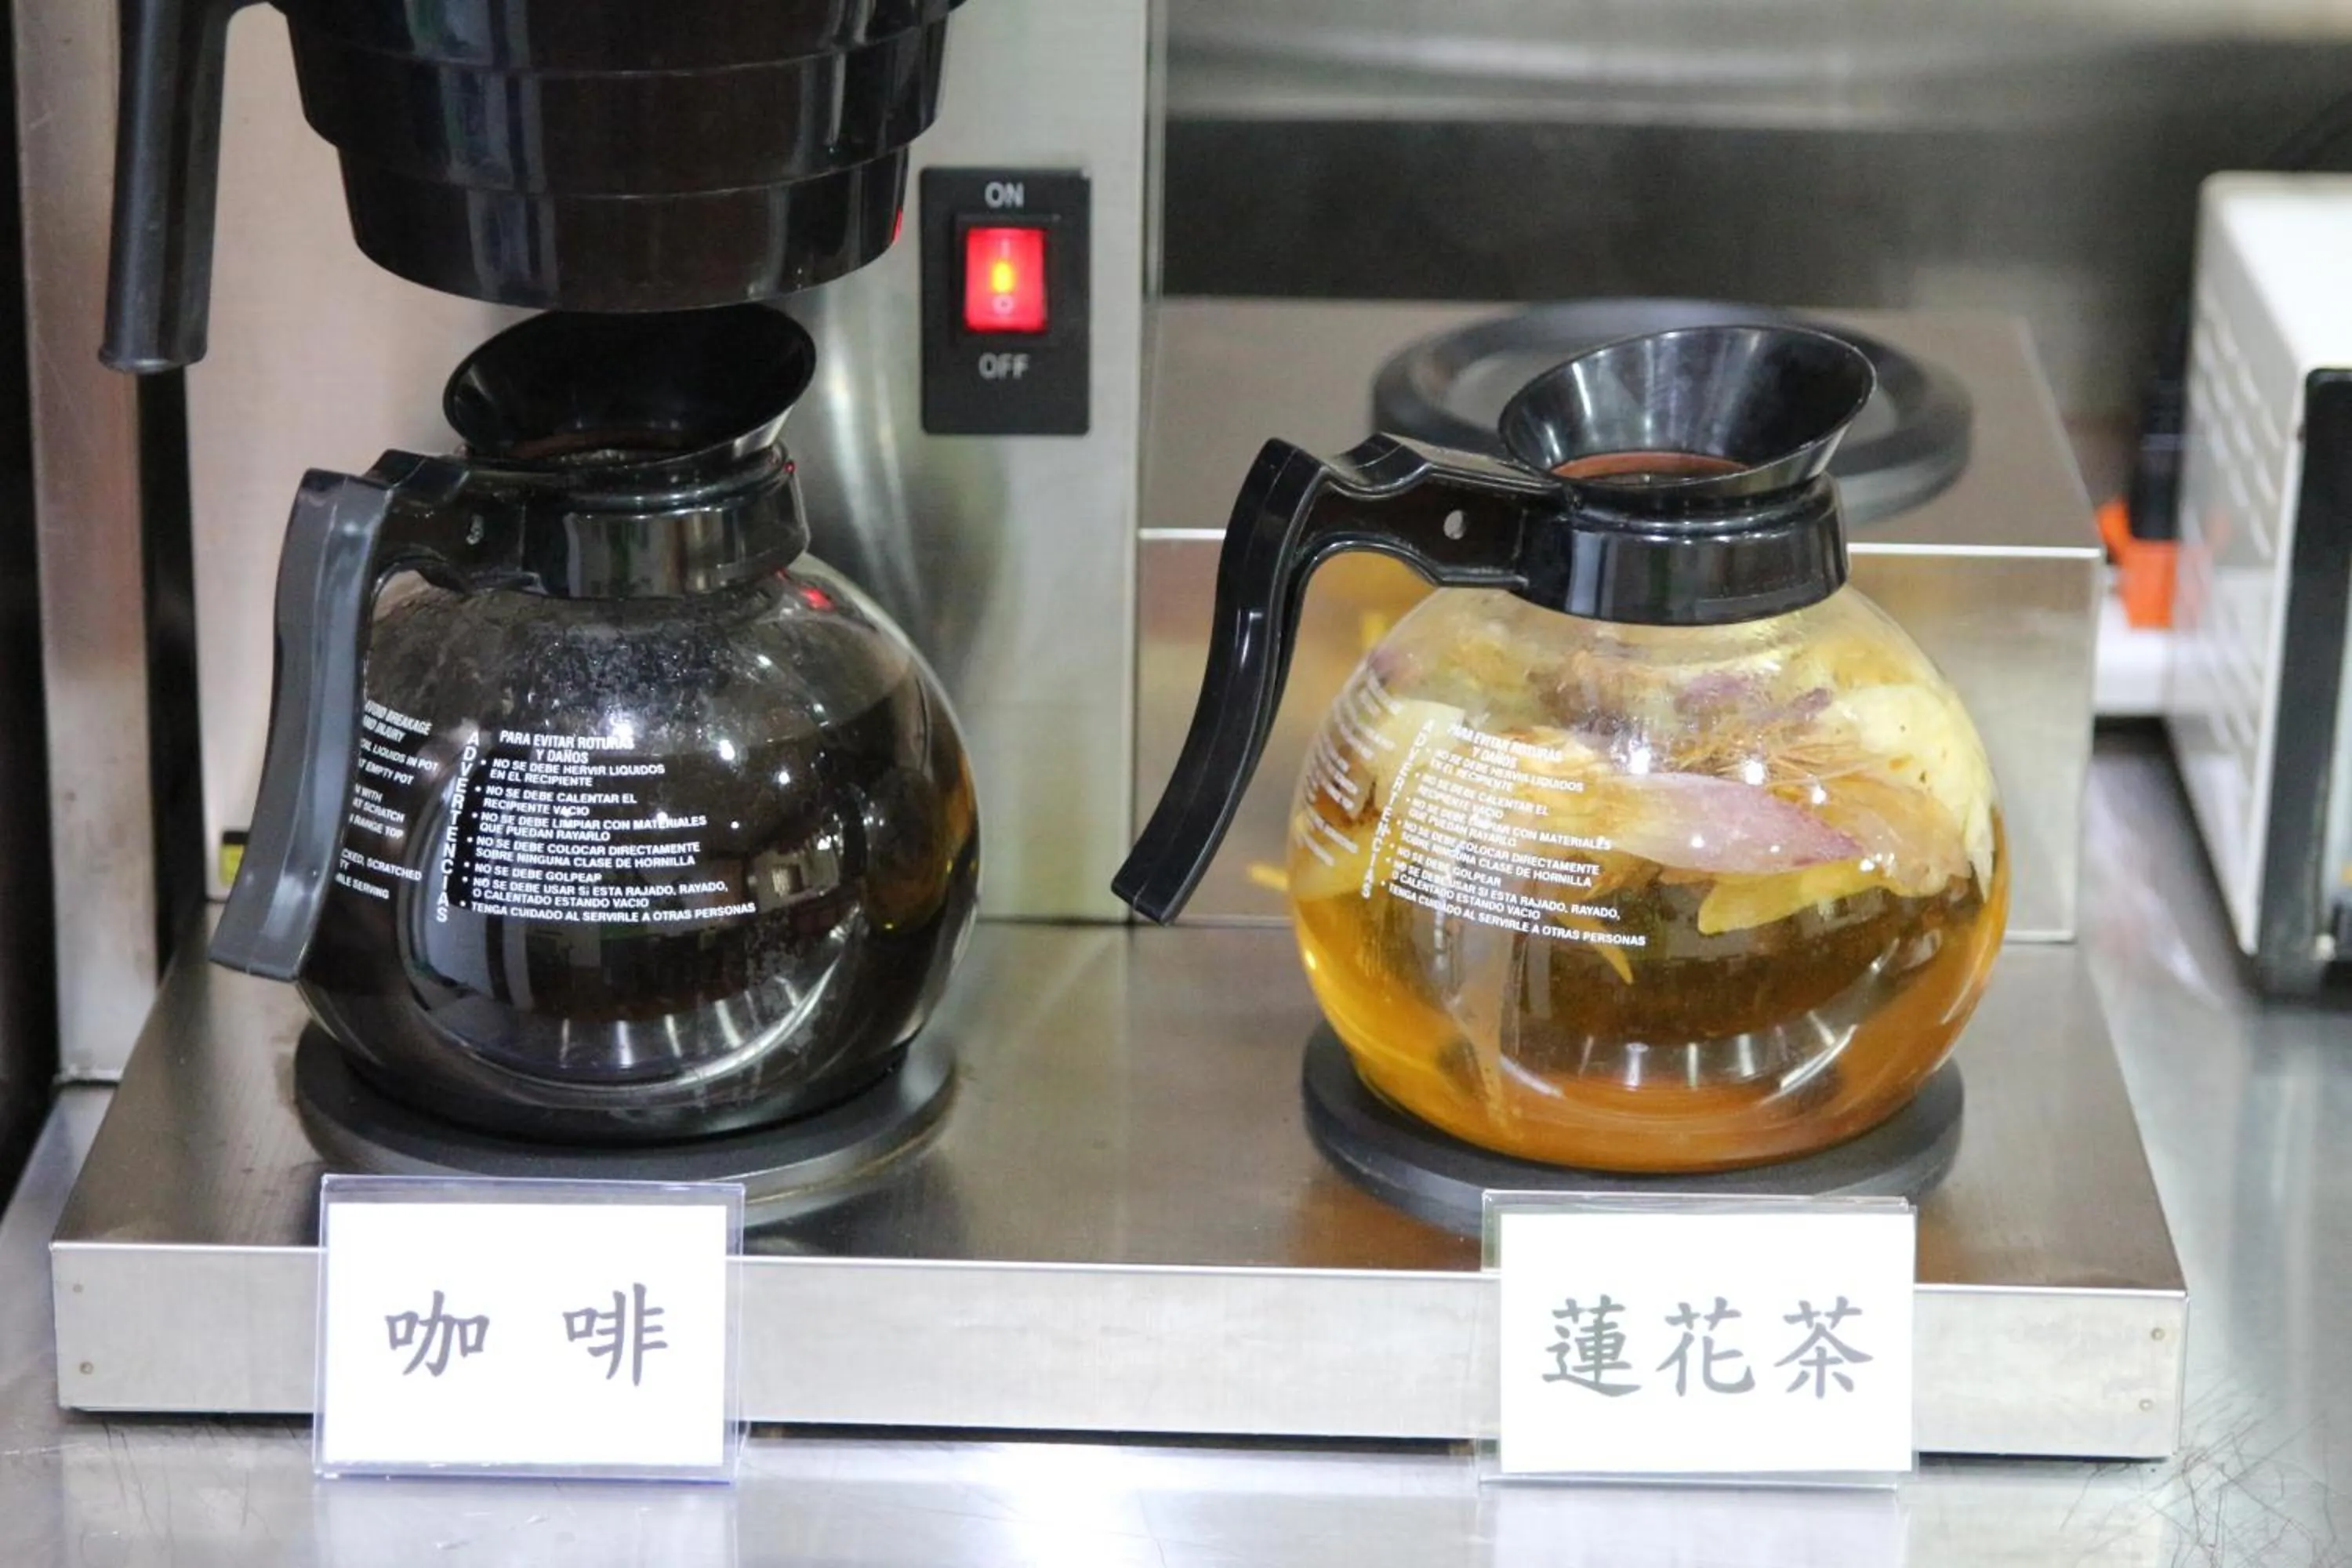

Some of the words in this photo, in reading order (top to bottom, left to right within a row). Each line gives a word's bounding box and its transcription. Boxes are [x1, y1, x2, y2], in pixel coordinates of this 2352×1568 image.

[985, 182, 1024, 208] ON
[978, 353, 1031, 379] OFF
[499, 730, 530, 745] PARA
[534, 734, 574, 749] EVITAR
[536, 750, 546, 760] Y
[492, 758, 509, 769] NO
[512, 761, 527, 771] SE
[530, 763, 560, 773] DEBE
[563, 765, 606, 775] HERVIR
[609, 764, 666, 775] LIQUIDOS
[490, 769, 505, 779] EN
[510, 771, 521, 782] EL
[524, 775, 593, 787] RECIPIENTE
[486, 786, 503, 796] NO
[505, 787, 520, 798] SE
[523, 790, 554, 800] DEBE
[557, 793, 619, 804] CALENTAR
[622, 793, 637, 804] EL
[483, 798, 550, 814] RECIPIENTE
[436, 731, 480, 923] ADVERTENCIAS
[481, 811, 497, 822] NO
[500, 815, 515, 825] SE
[518, 817, 549, 828] DEBE
[552, 818, 601, 830] LIMPIAR
[603, 820, 630, 830] CON
[633, 816, 707, 830] MATERIALES
[480, 823, 503, 833] QUE
[506, 826, 554, 839] PUEDAN
[556, 829, 610, 841] RAYARLO
[1512, 826, 1536, 840] CON
[1539, 833, 1612, 851] MATERIALES
[476, 836, 493, 847] NO
[496, 838, 510, 849] SE
[514, 840, 545, 852] DEBE
[547, 844, 605, 855] COLOCAR
[608, 841, 701, 855] DIRECTAMENTE
[475, 848, 514, 862] SOBRE
[517, 853, 571, 867] NINGUNA
[573, 857, 612, 868] CLASE
[615, 858, 632, 868] DE
[635, 855, 695, 868] HORNILLA
[1512, 852, 1599, 876] DIRECTAMENTE
[474, 862, 492, 873] NO
[494, 866, 509, 877] SE
[512, 868, 543, 880] DEBE
[1453, 867, 1502, 887] GOLPEAR
[1479, 858, 1513, 875] CLASE
[1515, 866, 1531, 878] DE
[1533, 869, 1592, 888] HORNILLA
[473, 877, 490, 888] NO
[492, 880, 507, 891] SE
[510, 882, 541, 893] DEBE
[543, 884, 575, 895] USAR
[593, 886, 623, 896] ESTA
[1490, 889, 1518, 902] ESTA
[473, 888, 481, 898] O
[484, 888, 551, 906] CALENTADO
[554, 896, 609, 908] ESTANDO
[612, 898, 649, 908] VACIO
[1456, 894, 1504, 913] ESTANDO
[471, 902, 507, 916] TENGA
[510, 907, 562, 920] CUIDADO
[564, 910, 580, 920] AL
[583, 912, 638, 923] SERVIRLE
[641, 913, 651, 922] A
[653, 909, 691, 920] OTRAS
[695, 902, 756, 919] PERSONAS
[1479, 913, 1530, 932] SERVIRLE
[1531, 924, 1540, 935] A
[1542, 926, 1581, 940] OTRAS
[1583, 931, 1646, 947] PERSONAS
[385, 1283, 668, 1386] 咖啡
[1542, 1294, 1874, 1399] 蓮花茶
